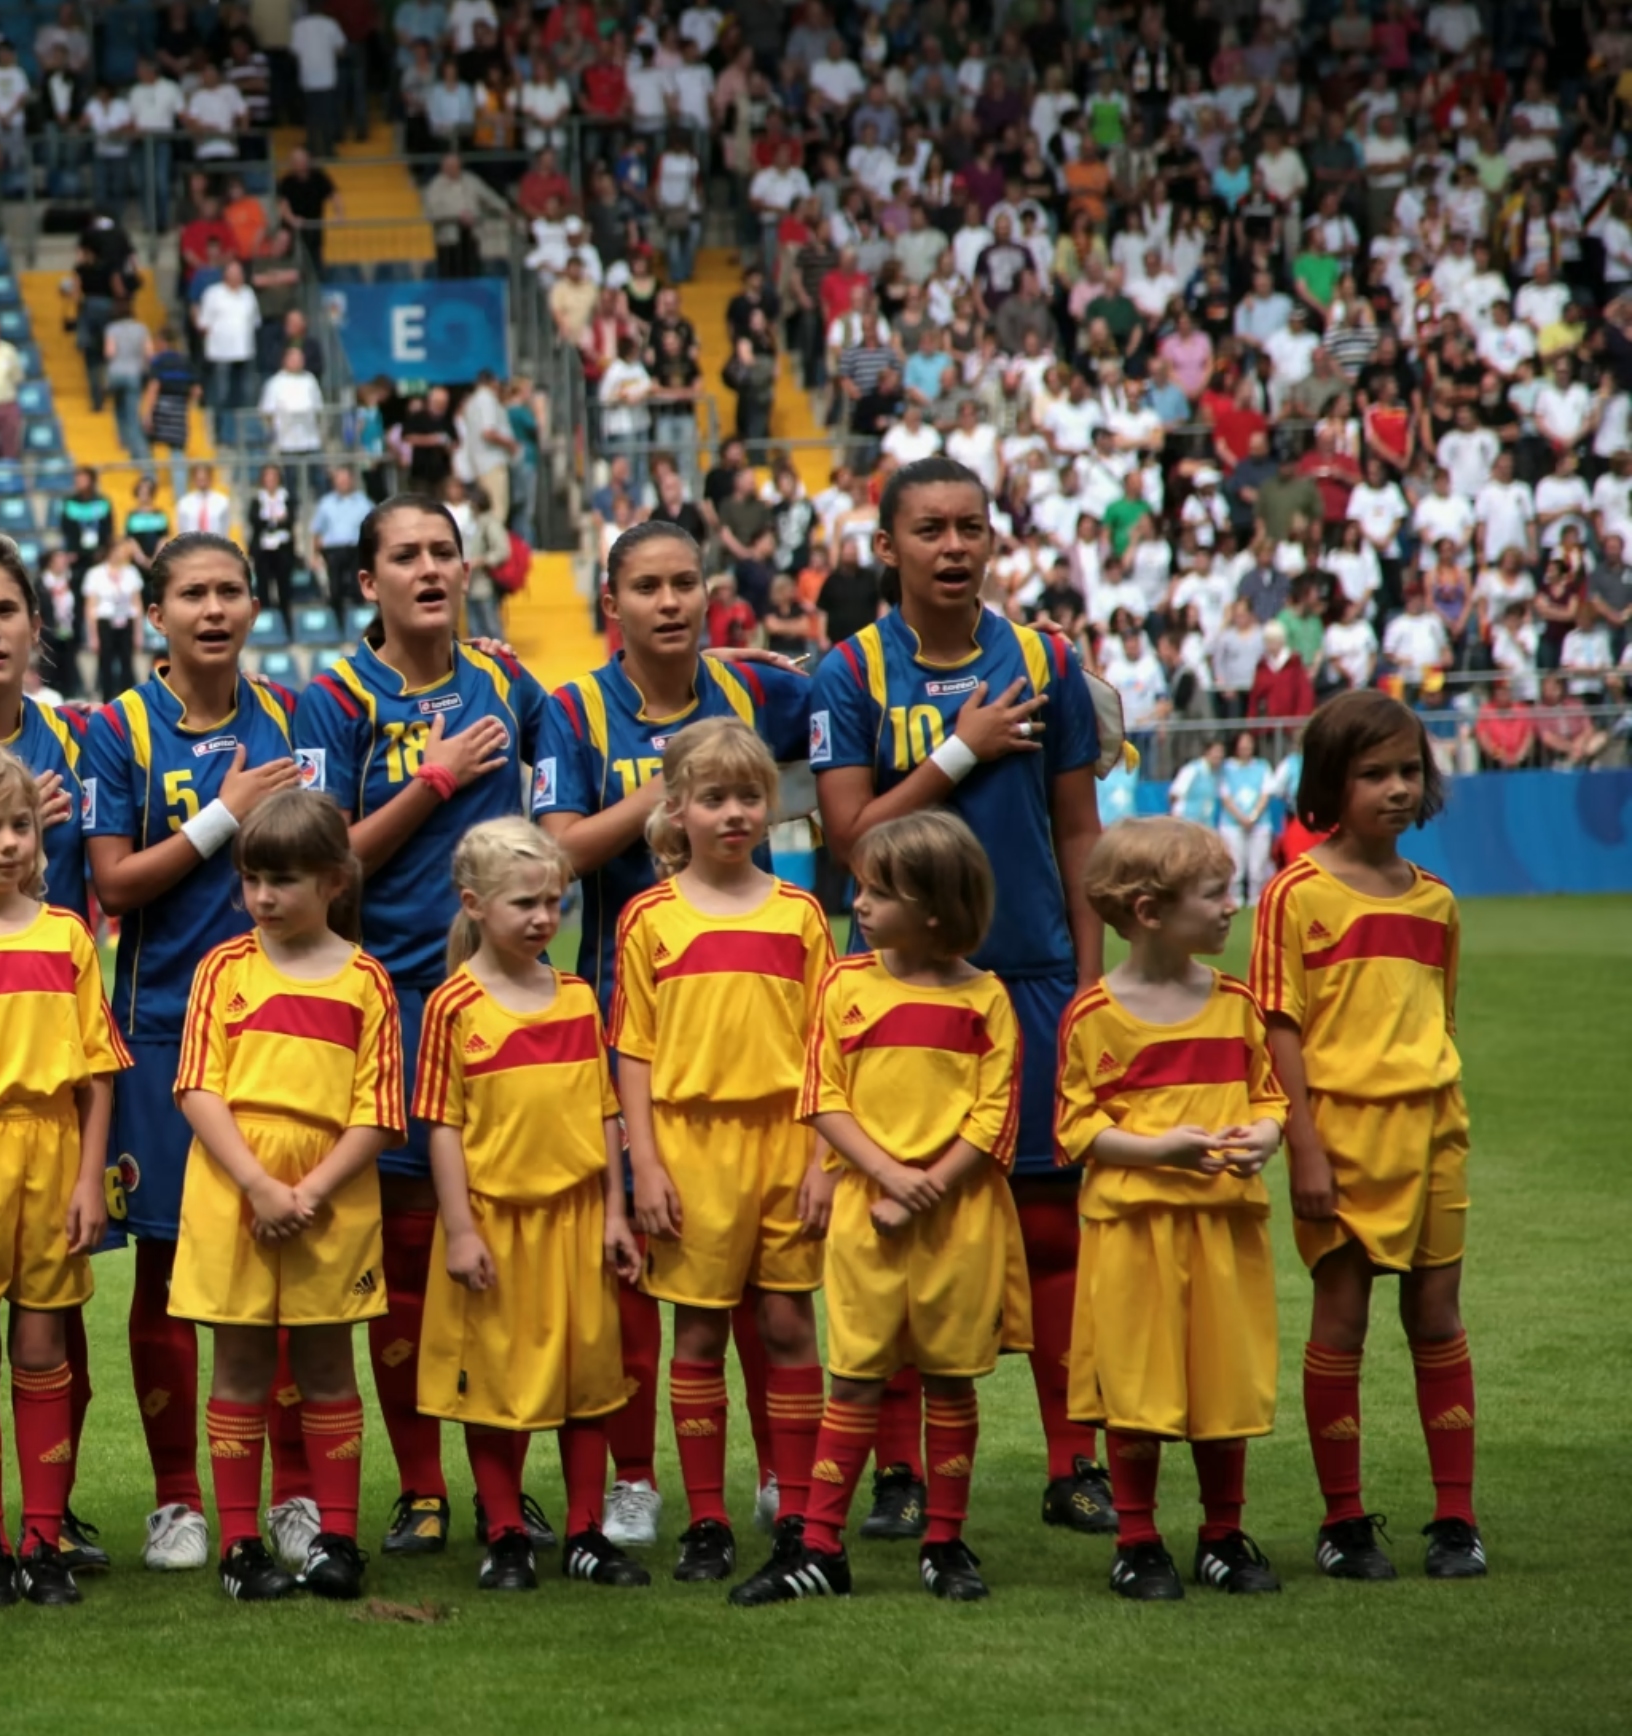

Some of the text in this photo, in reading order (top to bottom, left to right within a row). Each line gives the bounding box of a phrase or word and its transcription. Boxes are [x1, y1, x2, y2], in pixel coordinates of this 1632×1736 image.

[391, 304, 426, 362] E
[431, 698, 459, 710] lotto
[942, 680, 975, 692] lotto
[382, 720, 436, 783] 18
[889, 704, 946, 771] 10
[163, 769, 201, 834] 5
[104, 1165, 128, 1220] 6
